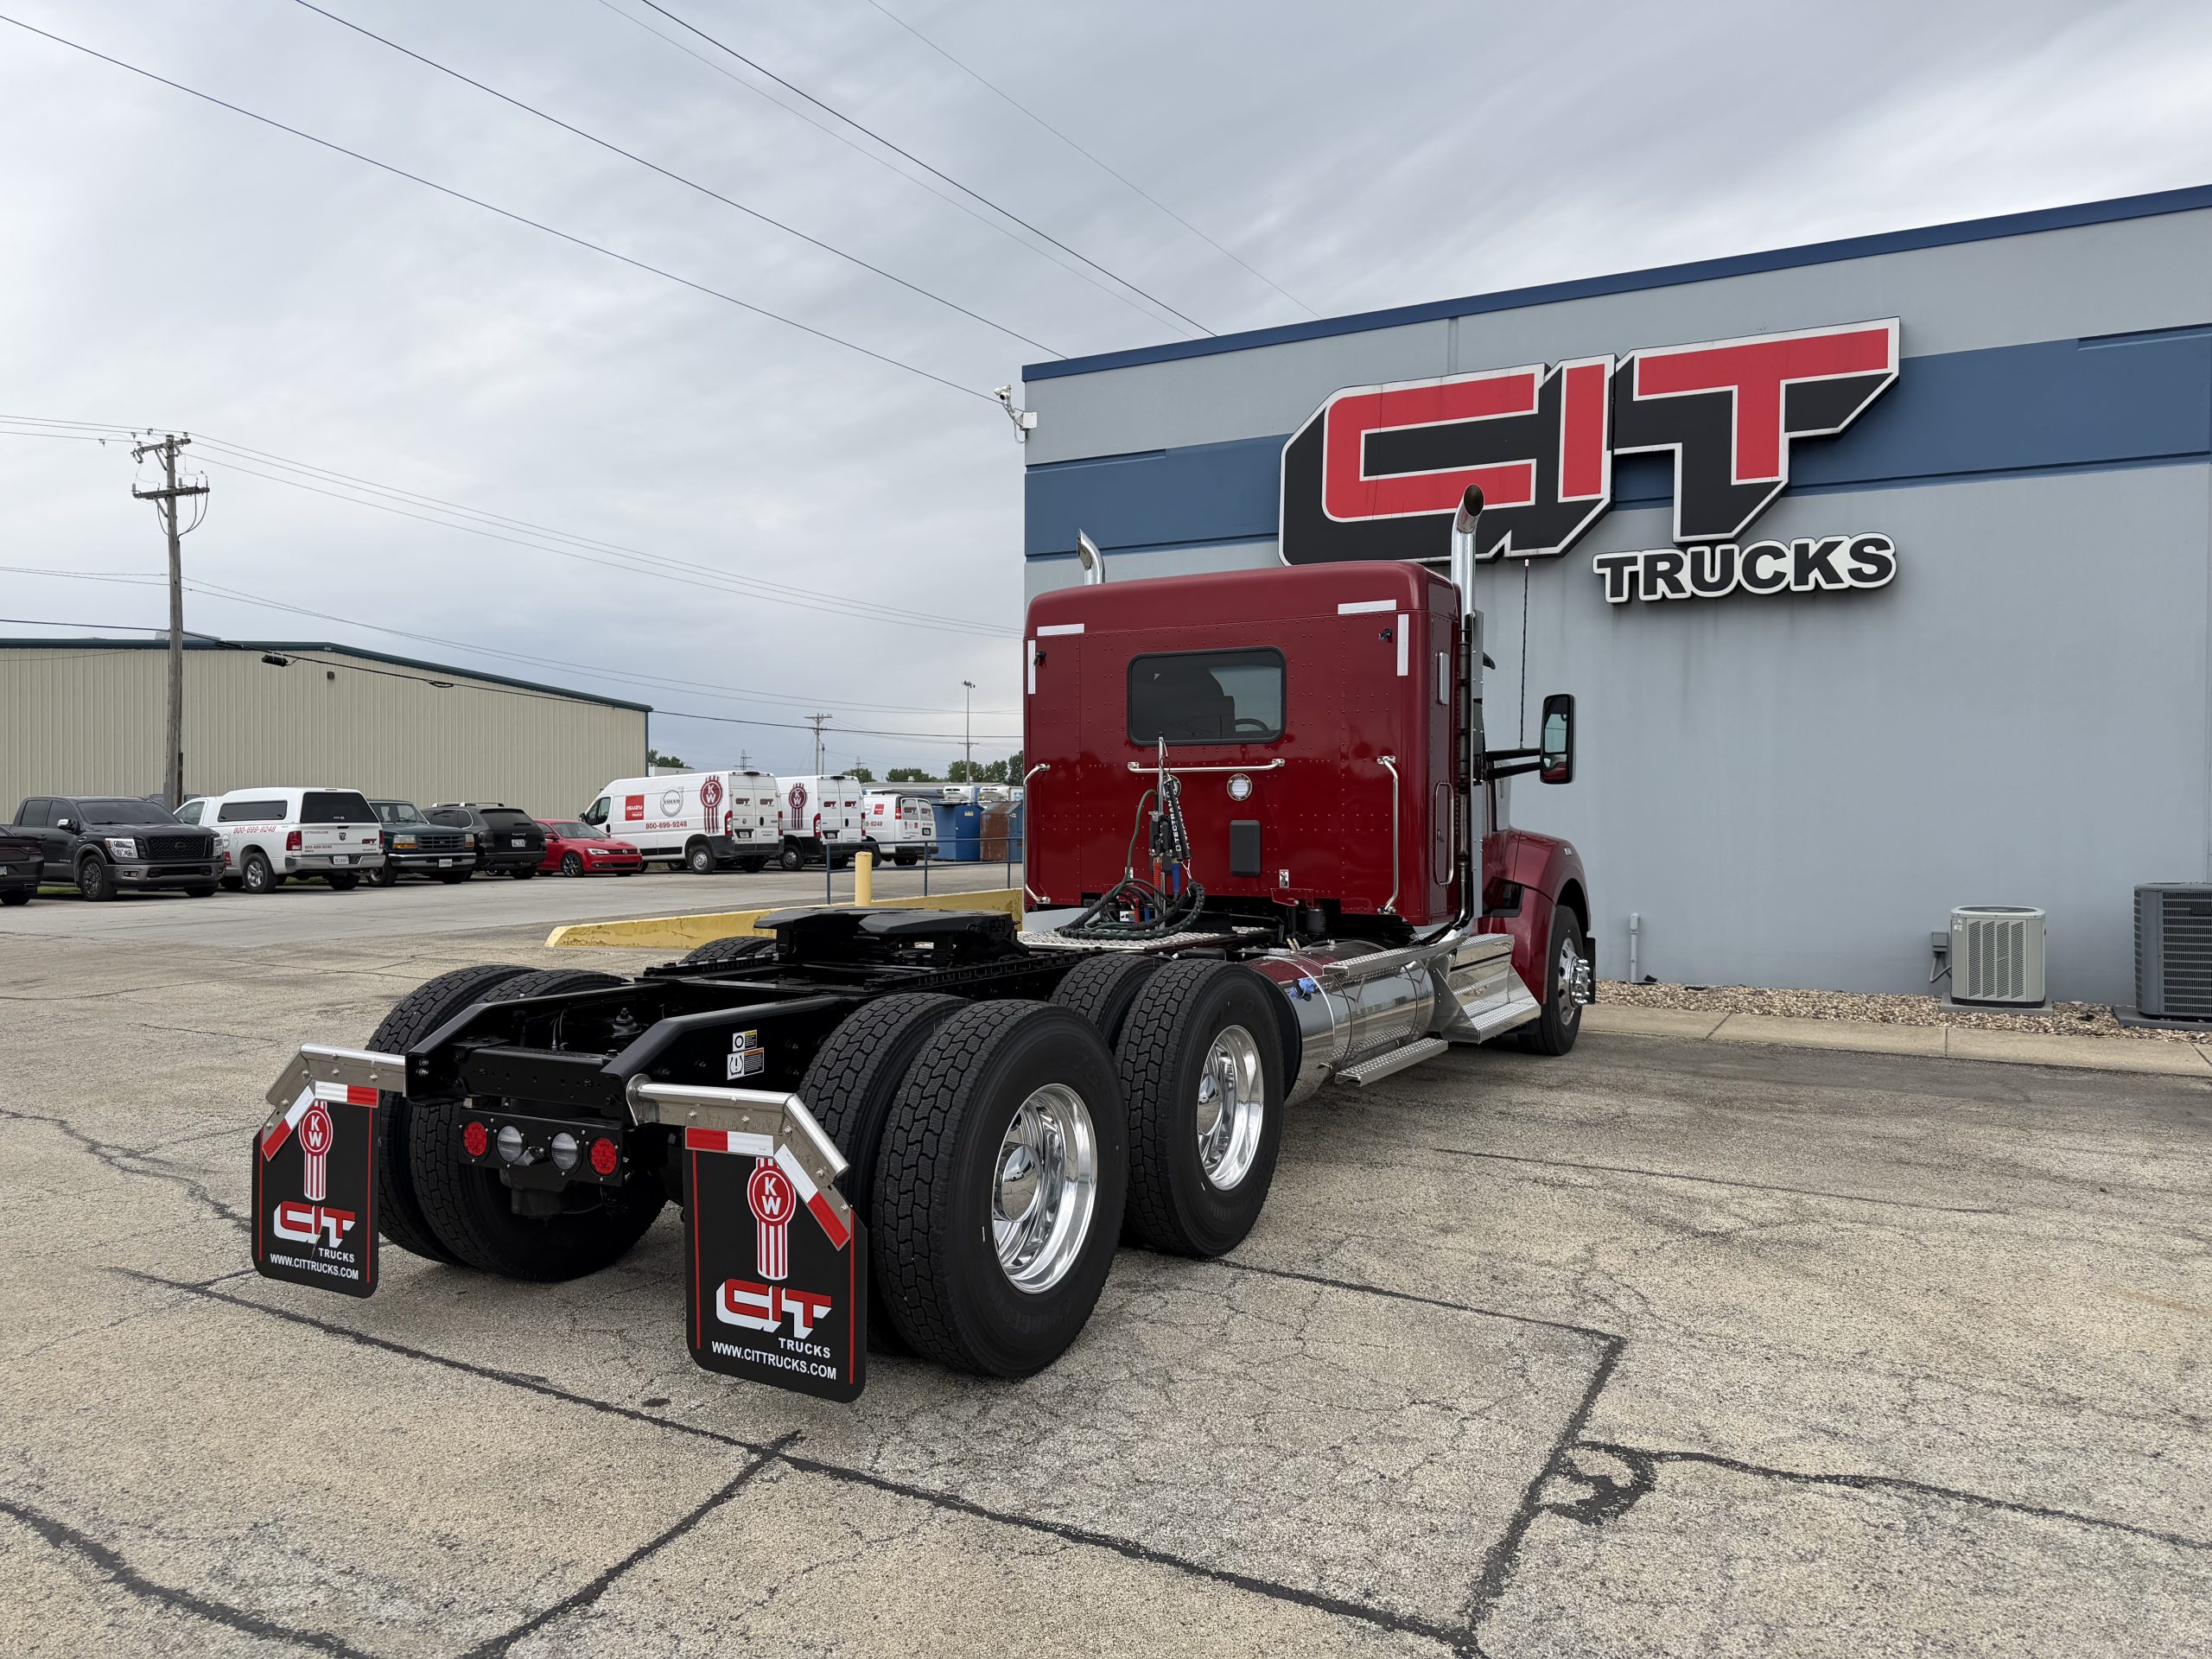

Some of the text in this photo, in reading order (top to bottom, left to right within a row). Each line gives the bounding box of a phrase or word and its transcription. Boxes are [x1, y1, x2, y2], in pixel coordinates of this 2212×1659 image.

[1284, 320, 1899, 557] CIT
[1593, 534, 1897, 602] TRUCKS
[233, 825, 276, 834] 800-699-9248
[645, 821, 688, 830] 800-699-9248
[1167, 800, 1180, 843] TECTRAN
[274, 1200, 356, 1249] CIT
[270, 1253, 359, 1281] WWW.CITTRUCKS.COM
[318, 1247, 355, 1263] TRUCKS
[715, 1278, 832, 1339] CIT
[711, 1340, 837, 1381] WWW.CITTRUCKS.COM
[778, 1337, 831, 1359] TRUCKS
